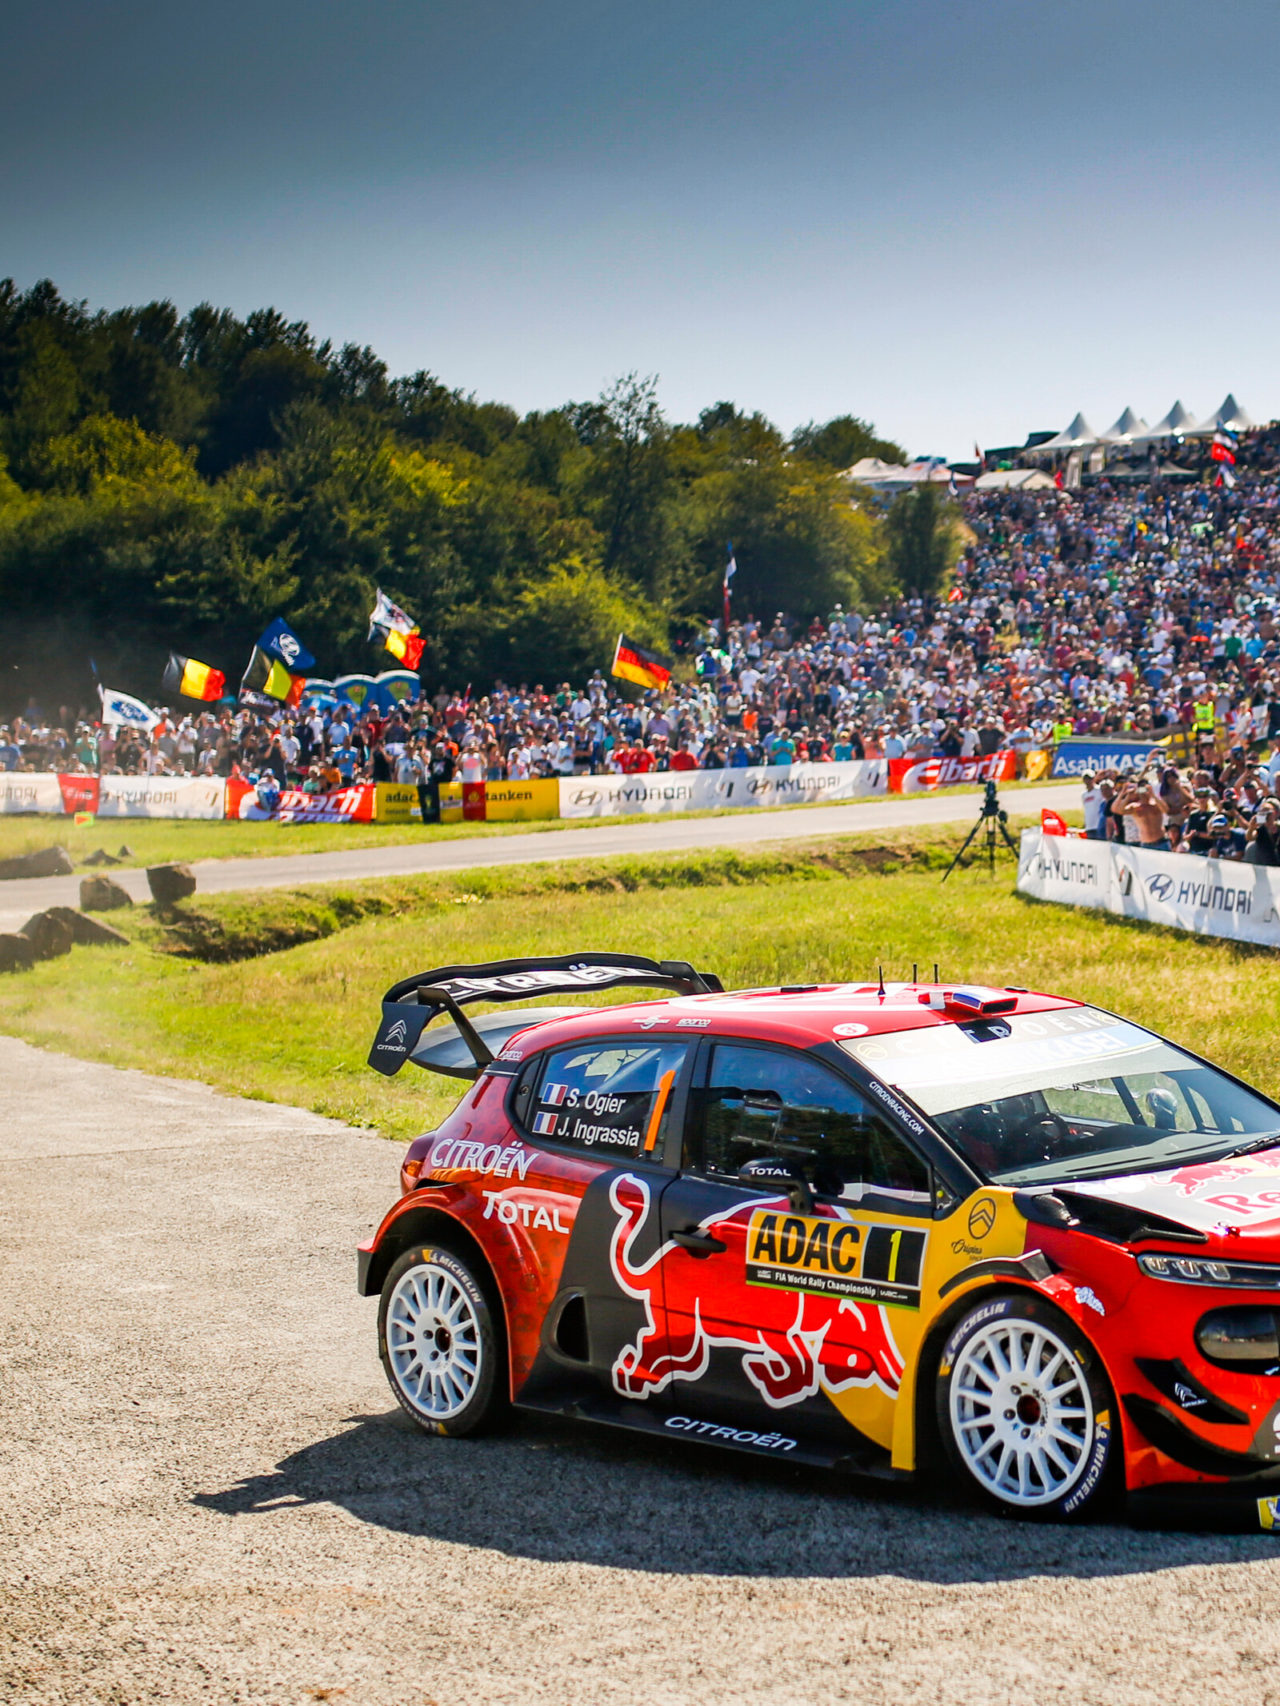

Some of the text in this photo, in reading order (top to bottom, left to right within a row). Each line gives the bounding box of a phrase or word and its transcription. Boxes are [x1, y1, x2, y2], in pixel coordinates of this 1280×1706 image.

[775, 775, 841, 792] HYUNDAI
[902, 753, 1006, 794] Eibach
[608, 785, 693, 801] HYUNDAI
[1042, 859, 1098, 886] HYUNDAI
[1177, 880, 1252, 915] HYUNDAI
[566, 1087, 627, 1117] S. Ogier
[557, 1116, 640, 1147] J. Ingrassia
[430, 1138, 539, 1181] CITROËN
[749, 1166, 792, 1177] TOTAL
[482, 1190, 570, 1235] TOTAL
[752, 1214, 903, 1282] ADAC 1
[441, 1256, 482, 1304] MICHELIN
[775, 1271, 787, 1282] FIA
[787, 1273, 808, 1285] World
[808, 1277, 826, 1290] Rally
[827, 1279, 877, 1298] Championship
[951, 1302, 1007, 1349] MICHELIN
[664, 1416, 798, 1451] CITROËN
[1065, 1443, 1107, 1513] MICHELIN
